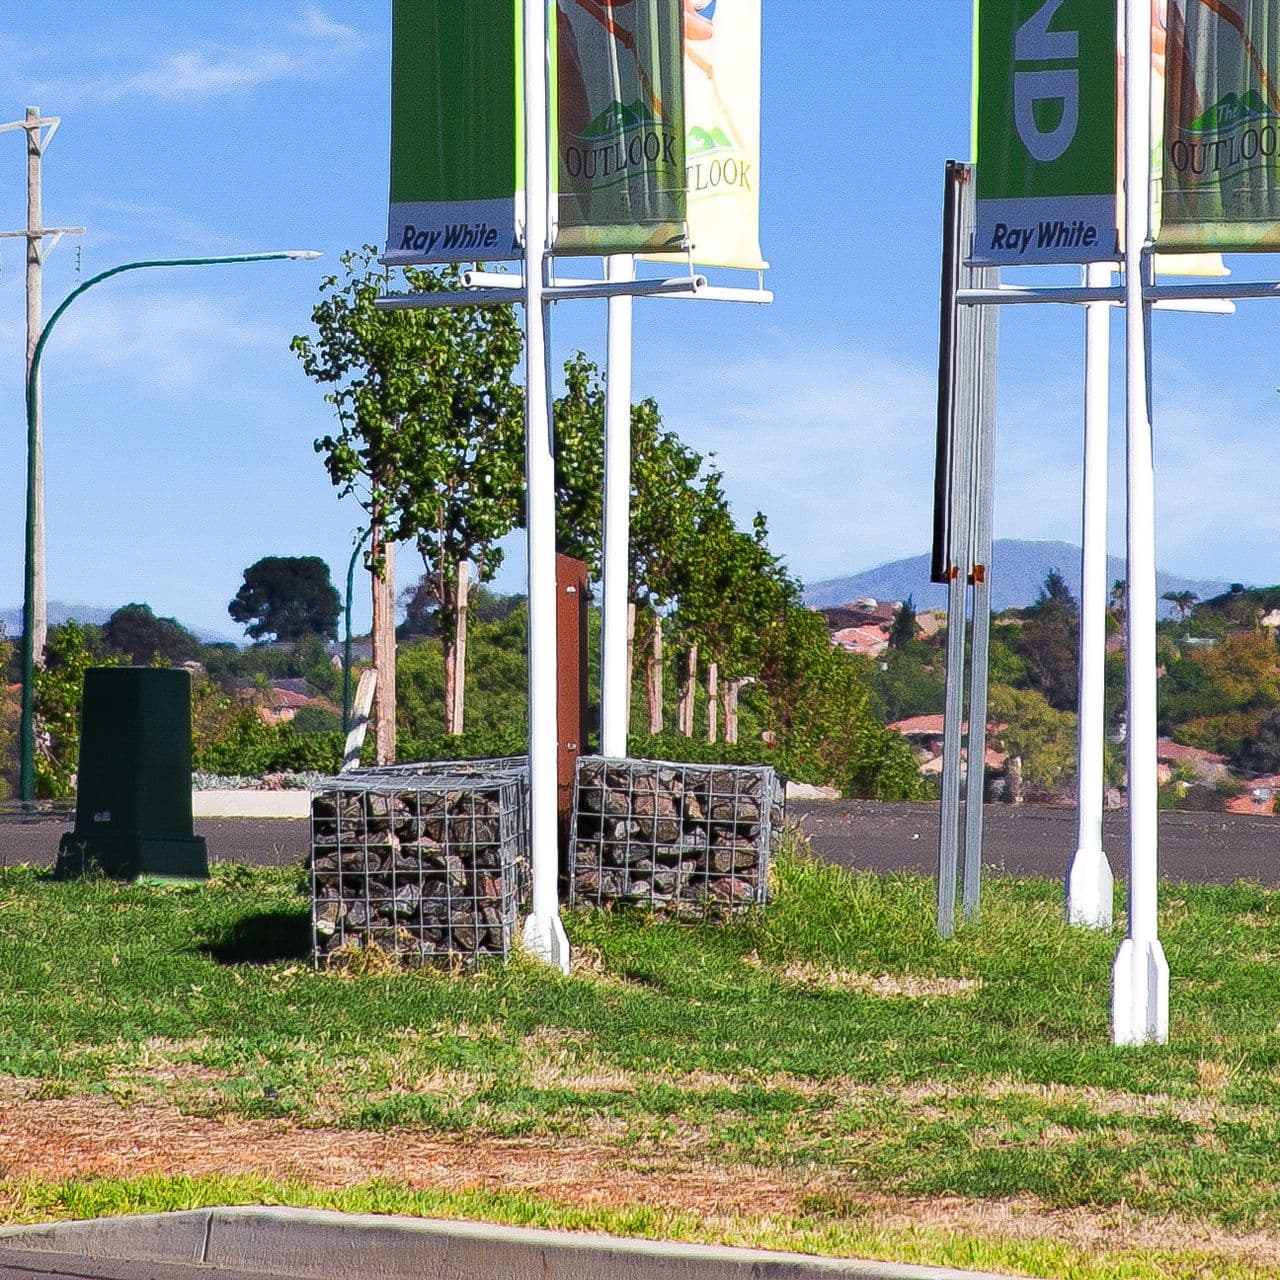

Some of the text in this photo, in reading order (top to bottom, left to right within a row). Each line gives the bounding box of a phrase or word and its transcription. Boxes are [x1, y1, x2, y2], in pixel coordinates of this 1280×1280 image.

[565, 131, 678, 180] OUTLOOK
[685, 157, 752, 192] TLOOK
[400, 224, 442, 255] Ray
[991, 222, 1036, 254] Ray
